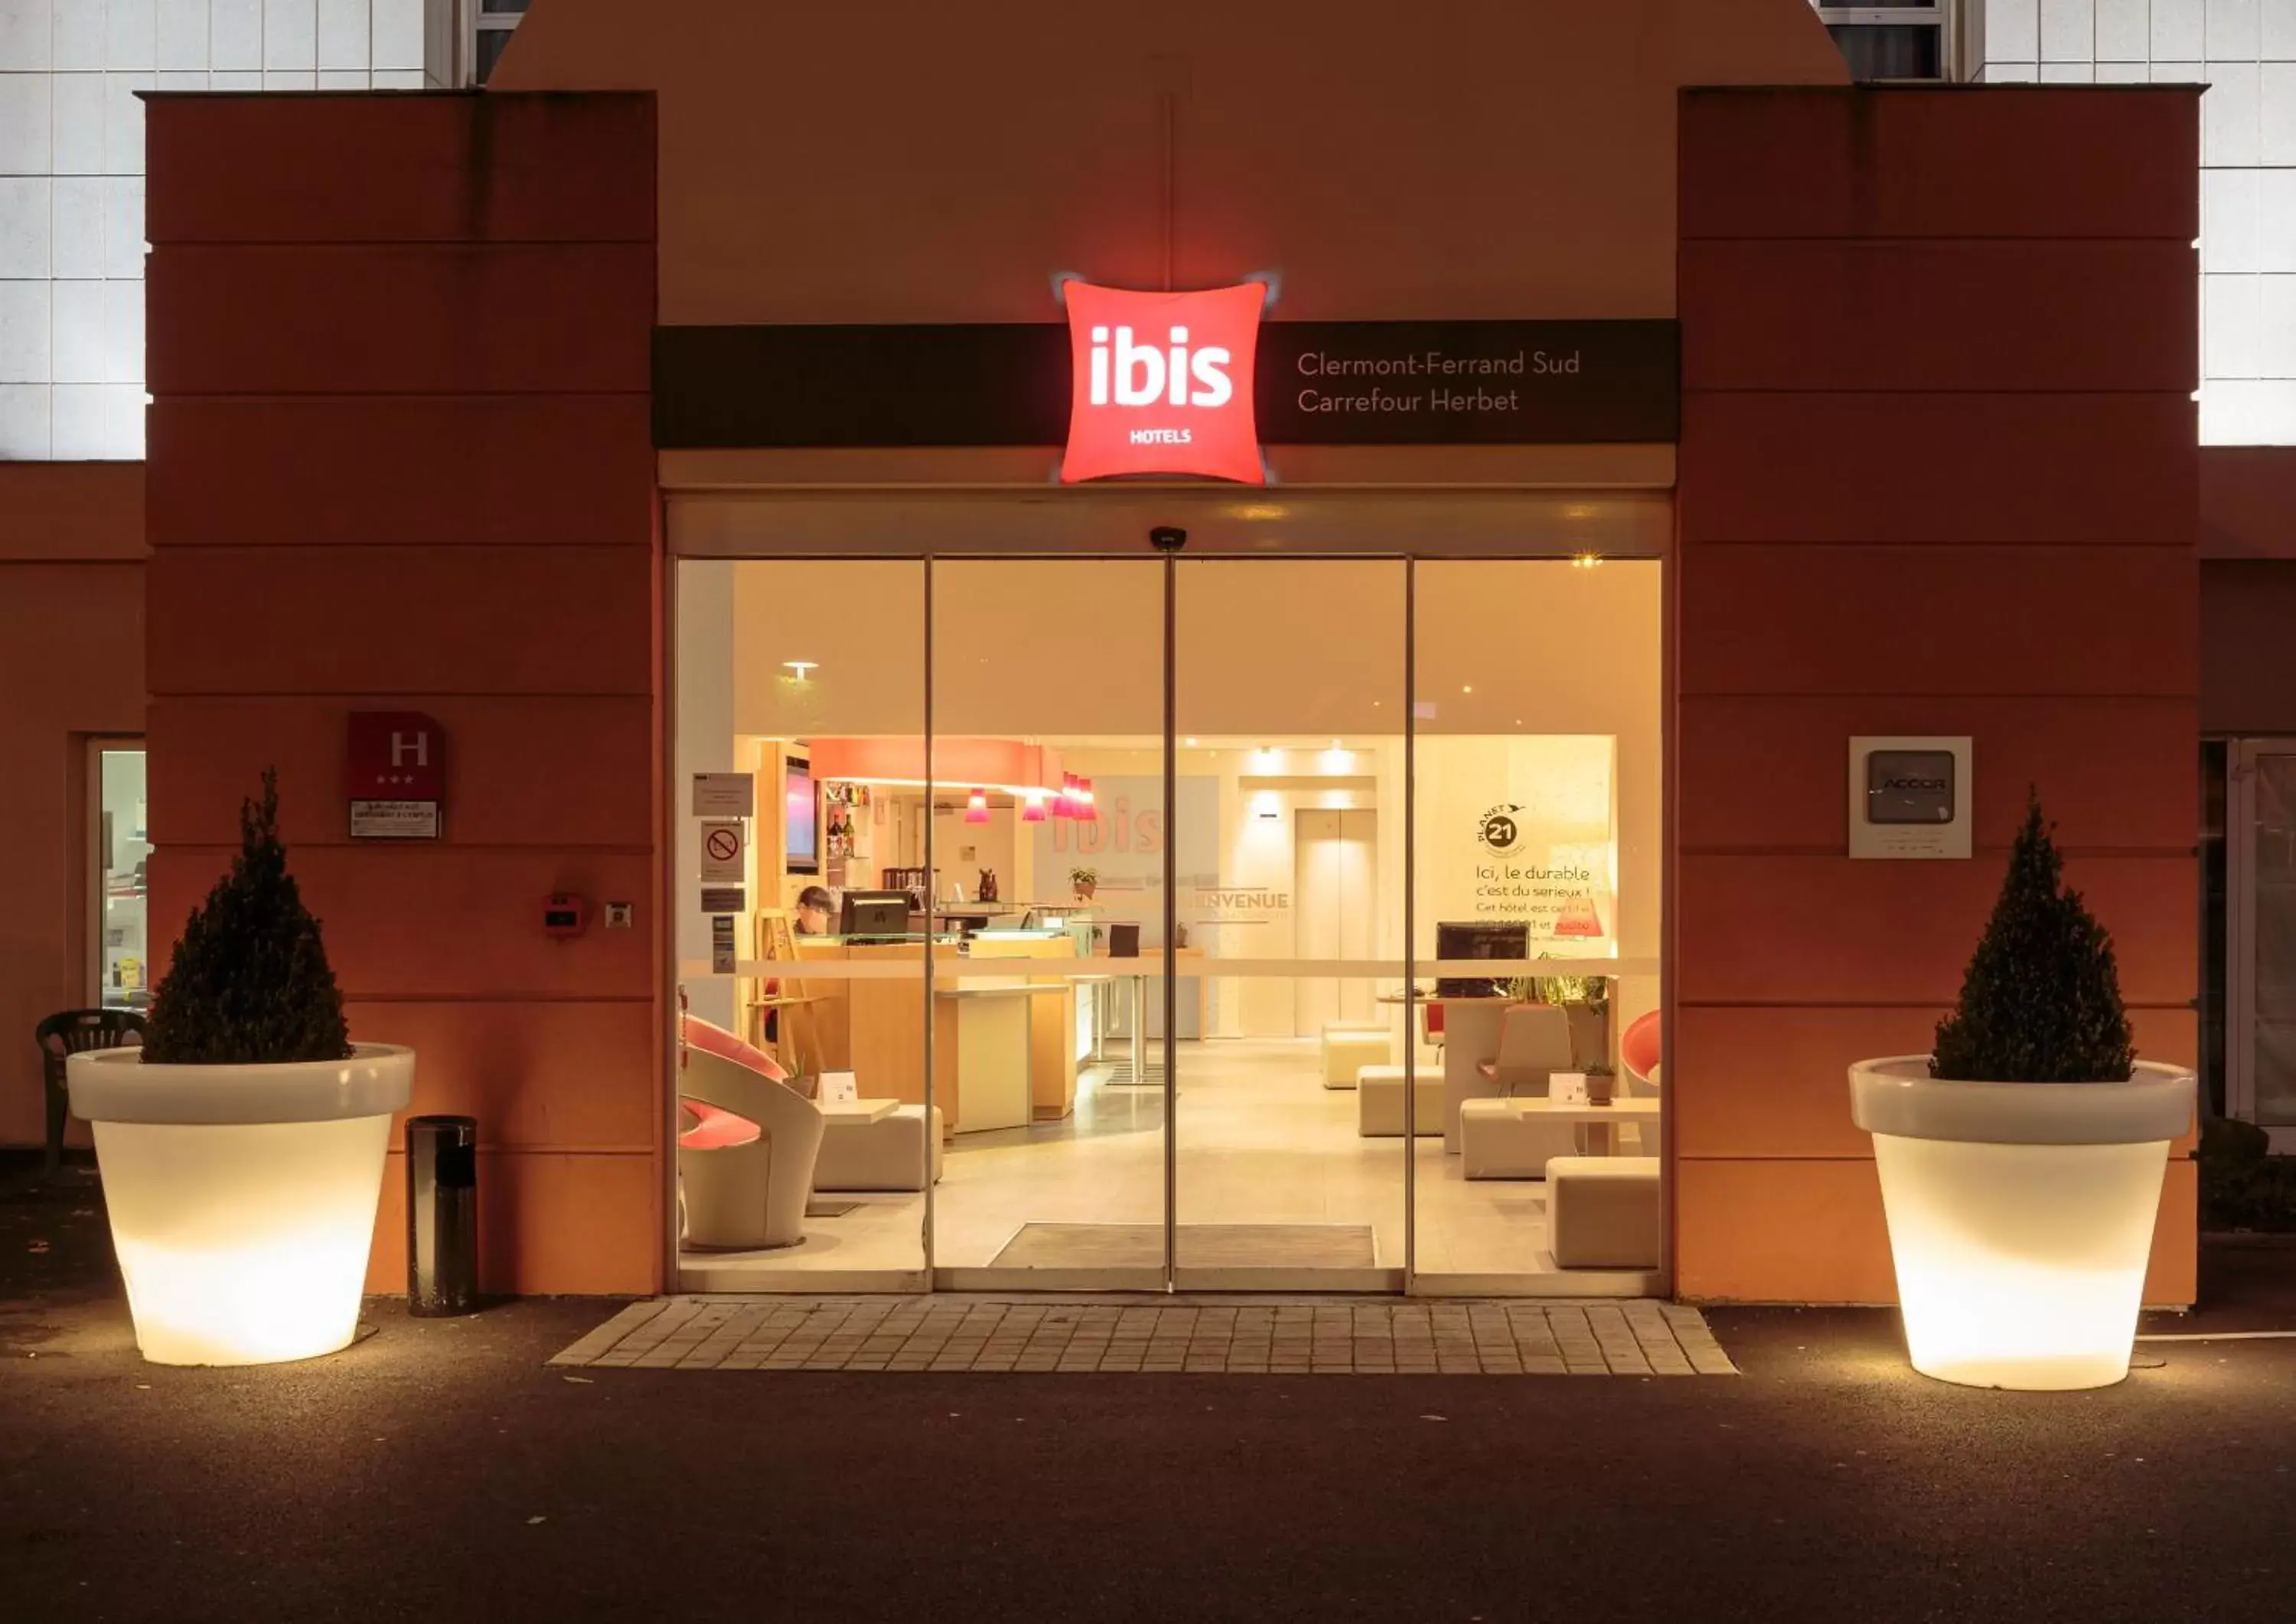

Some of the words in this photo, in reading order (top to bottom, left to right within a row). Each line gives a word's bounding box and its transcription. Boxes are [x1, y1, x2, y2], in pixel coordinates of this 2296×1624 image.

[1089, 325, 1233, 409] ibis
[1296, 351, 1524, 377] Clermont-Ferrand
[1533, 350, 1580, 374] Sud
[1297, 386, 1422, 413] Carrefour
[1430, 386, 1519, 412] Herbet
[1130, 428, 1192, 445] HOTELS
[392, 732, 428, 766] H
[1883, 778, 1946, 790] ACCOR
[1489, 823, 1512, 840] 21
[1476, 865, 1499, 882] Ici,
[1505, 864, 1521, 879] le
[1525, 865, 1590, 880] durable
[1512, 883, 1530, 896] du
